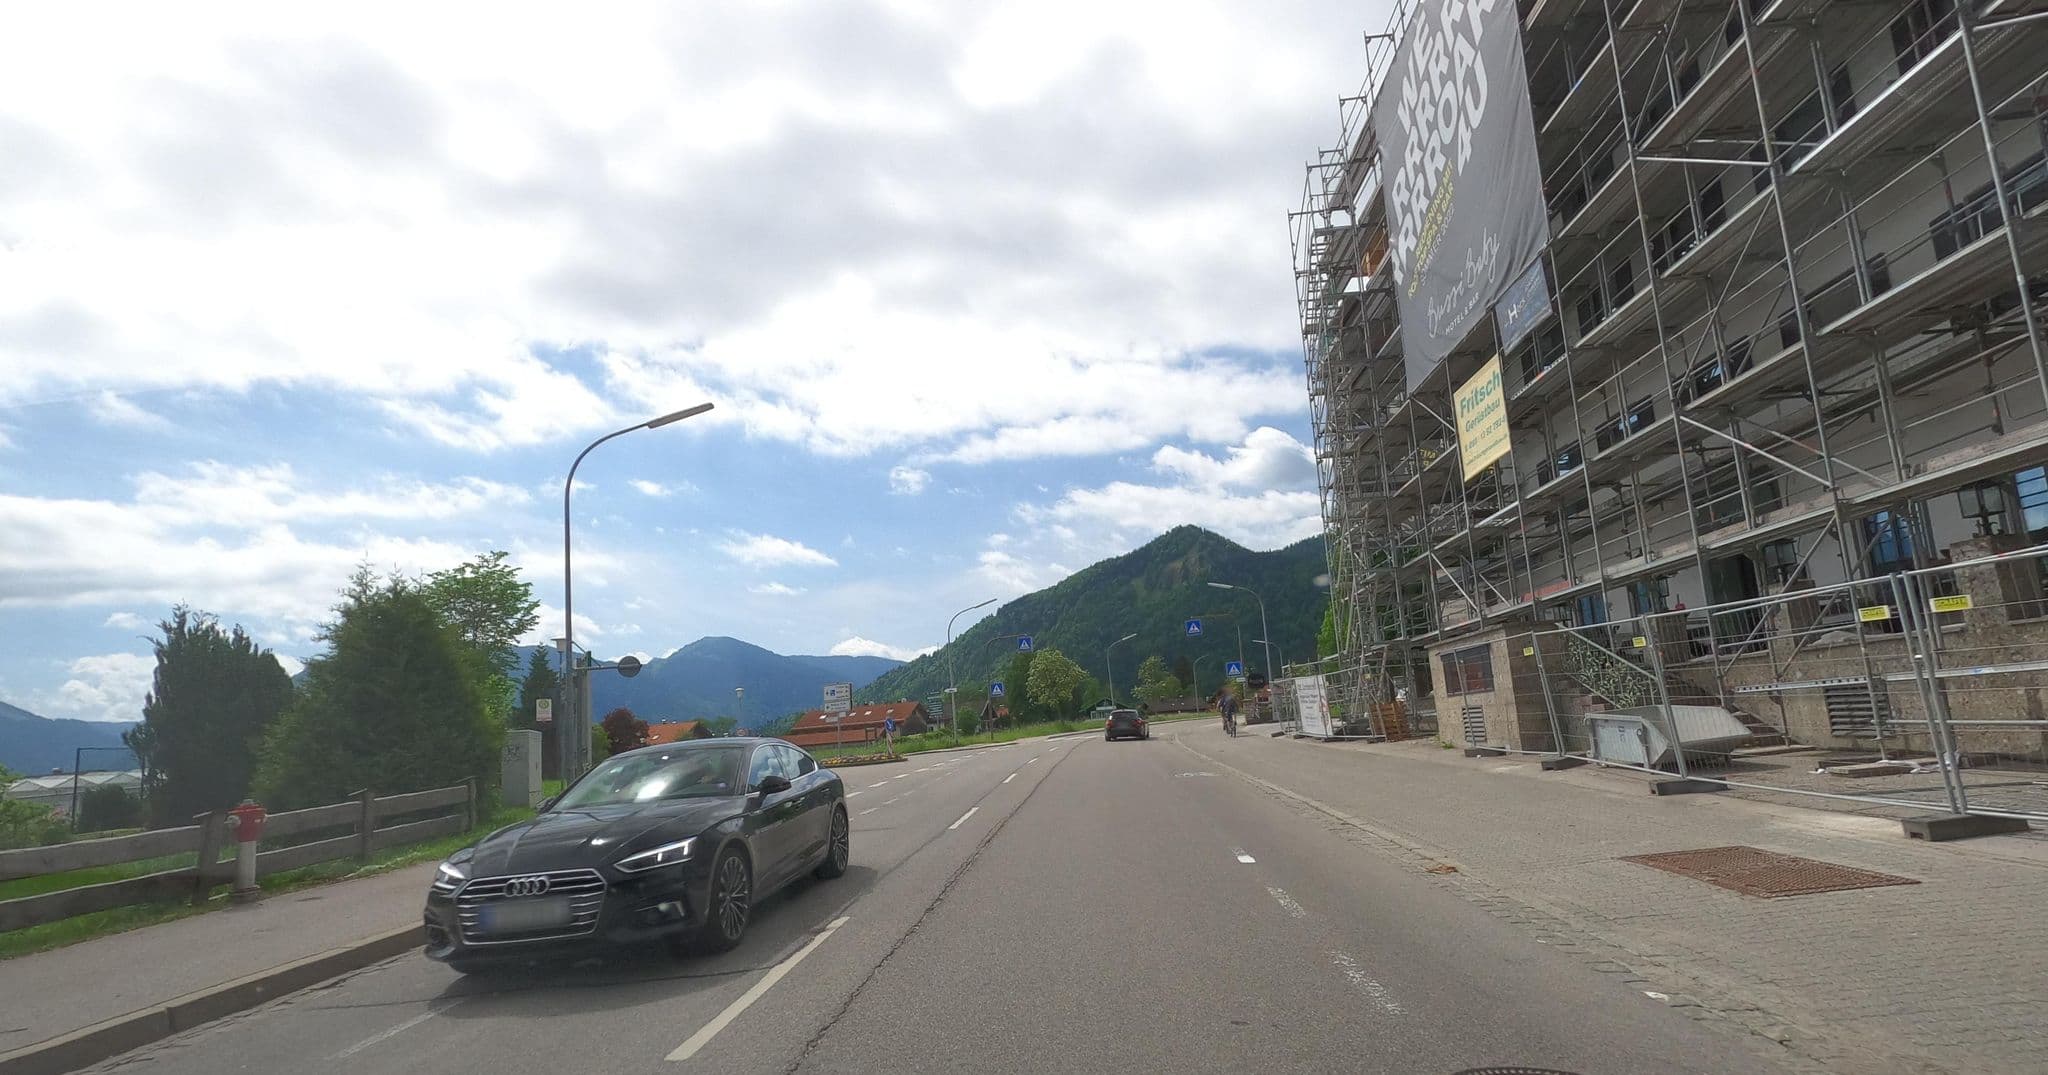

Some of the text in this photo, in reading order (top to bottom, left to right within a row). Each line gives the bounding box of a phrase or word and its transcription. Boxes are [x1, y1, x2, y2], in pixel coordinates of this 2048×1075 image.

[1397, 9, 1434, 134] WE
[1457, 50, 1489, 177] 4U
[1466, 226, 1500, 289] Baby
[1459, 370, 1502, 419] Fritsch
